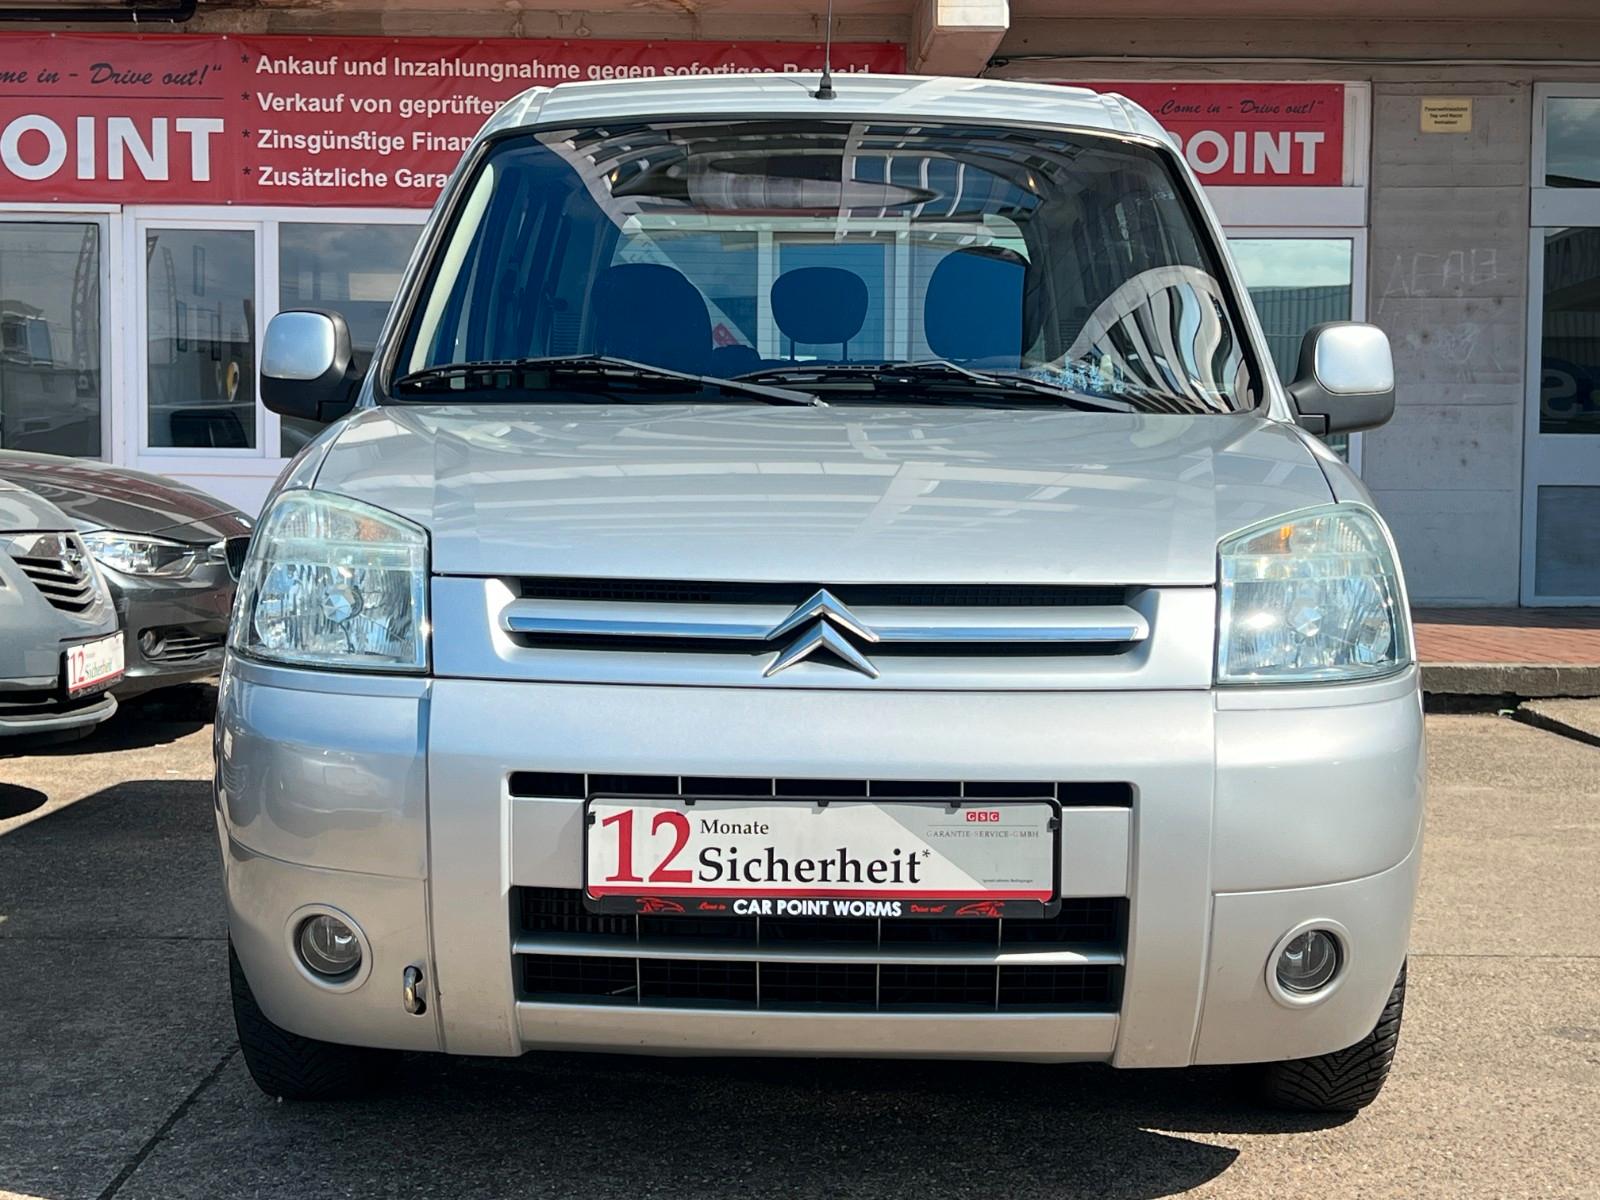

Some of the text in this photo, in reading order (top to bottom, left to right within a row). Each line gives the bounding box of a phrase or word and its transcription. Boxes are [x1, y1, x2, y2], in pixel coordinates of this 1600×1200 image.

[37, 68, 60, 82] in
[89, 63, 153, 85] Drive
[256, 55, 338, 75] Ankauf
[344, 57, 387, 76] und
[394, 58, 580, 82] Inzahlungnahme
[587, 64, 656, 79] gegen
[256, 92, 345, 113] Verkauf
[350, 98, 392, 113] von
[1206, 102, 1220, 113] in
[1240, 99, 1280, 114] Drive
[0, 113, 225, 182] OINT
[258, 129, 405, 155] Zinsgünstige
[258, 166, 388, 188] Zusätzliche
[71, 650, 85, 685] 12
[966, 811, 1000, 822] GSG
[602, 808, 769, 883] 12 Monate
[733, 899, 773, 915] CAR
[777, 900, 830, 916] POINT
[833, 901, 902, 916] WORMS
